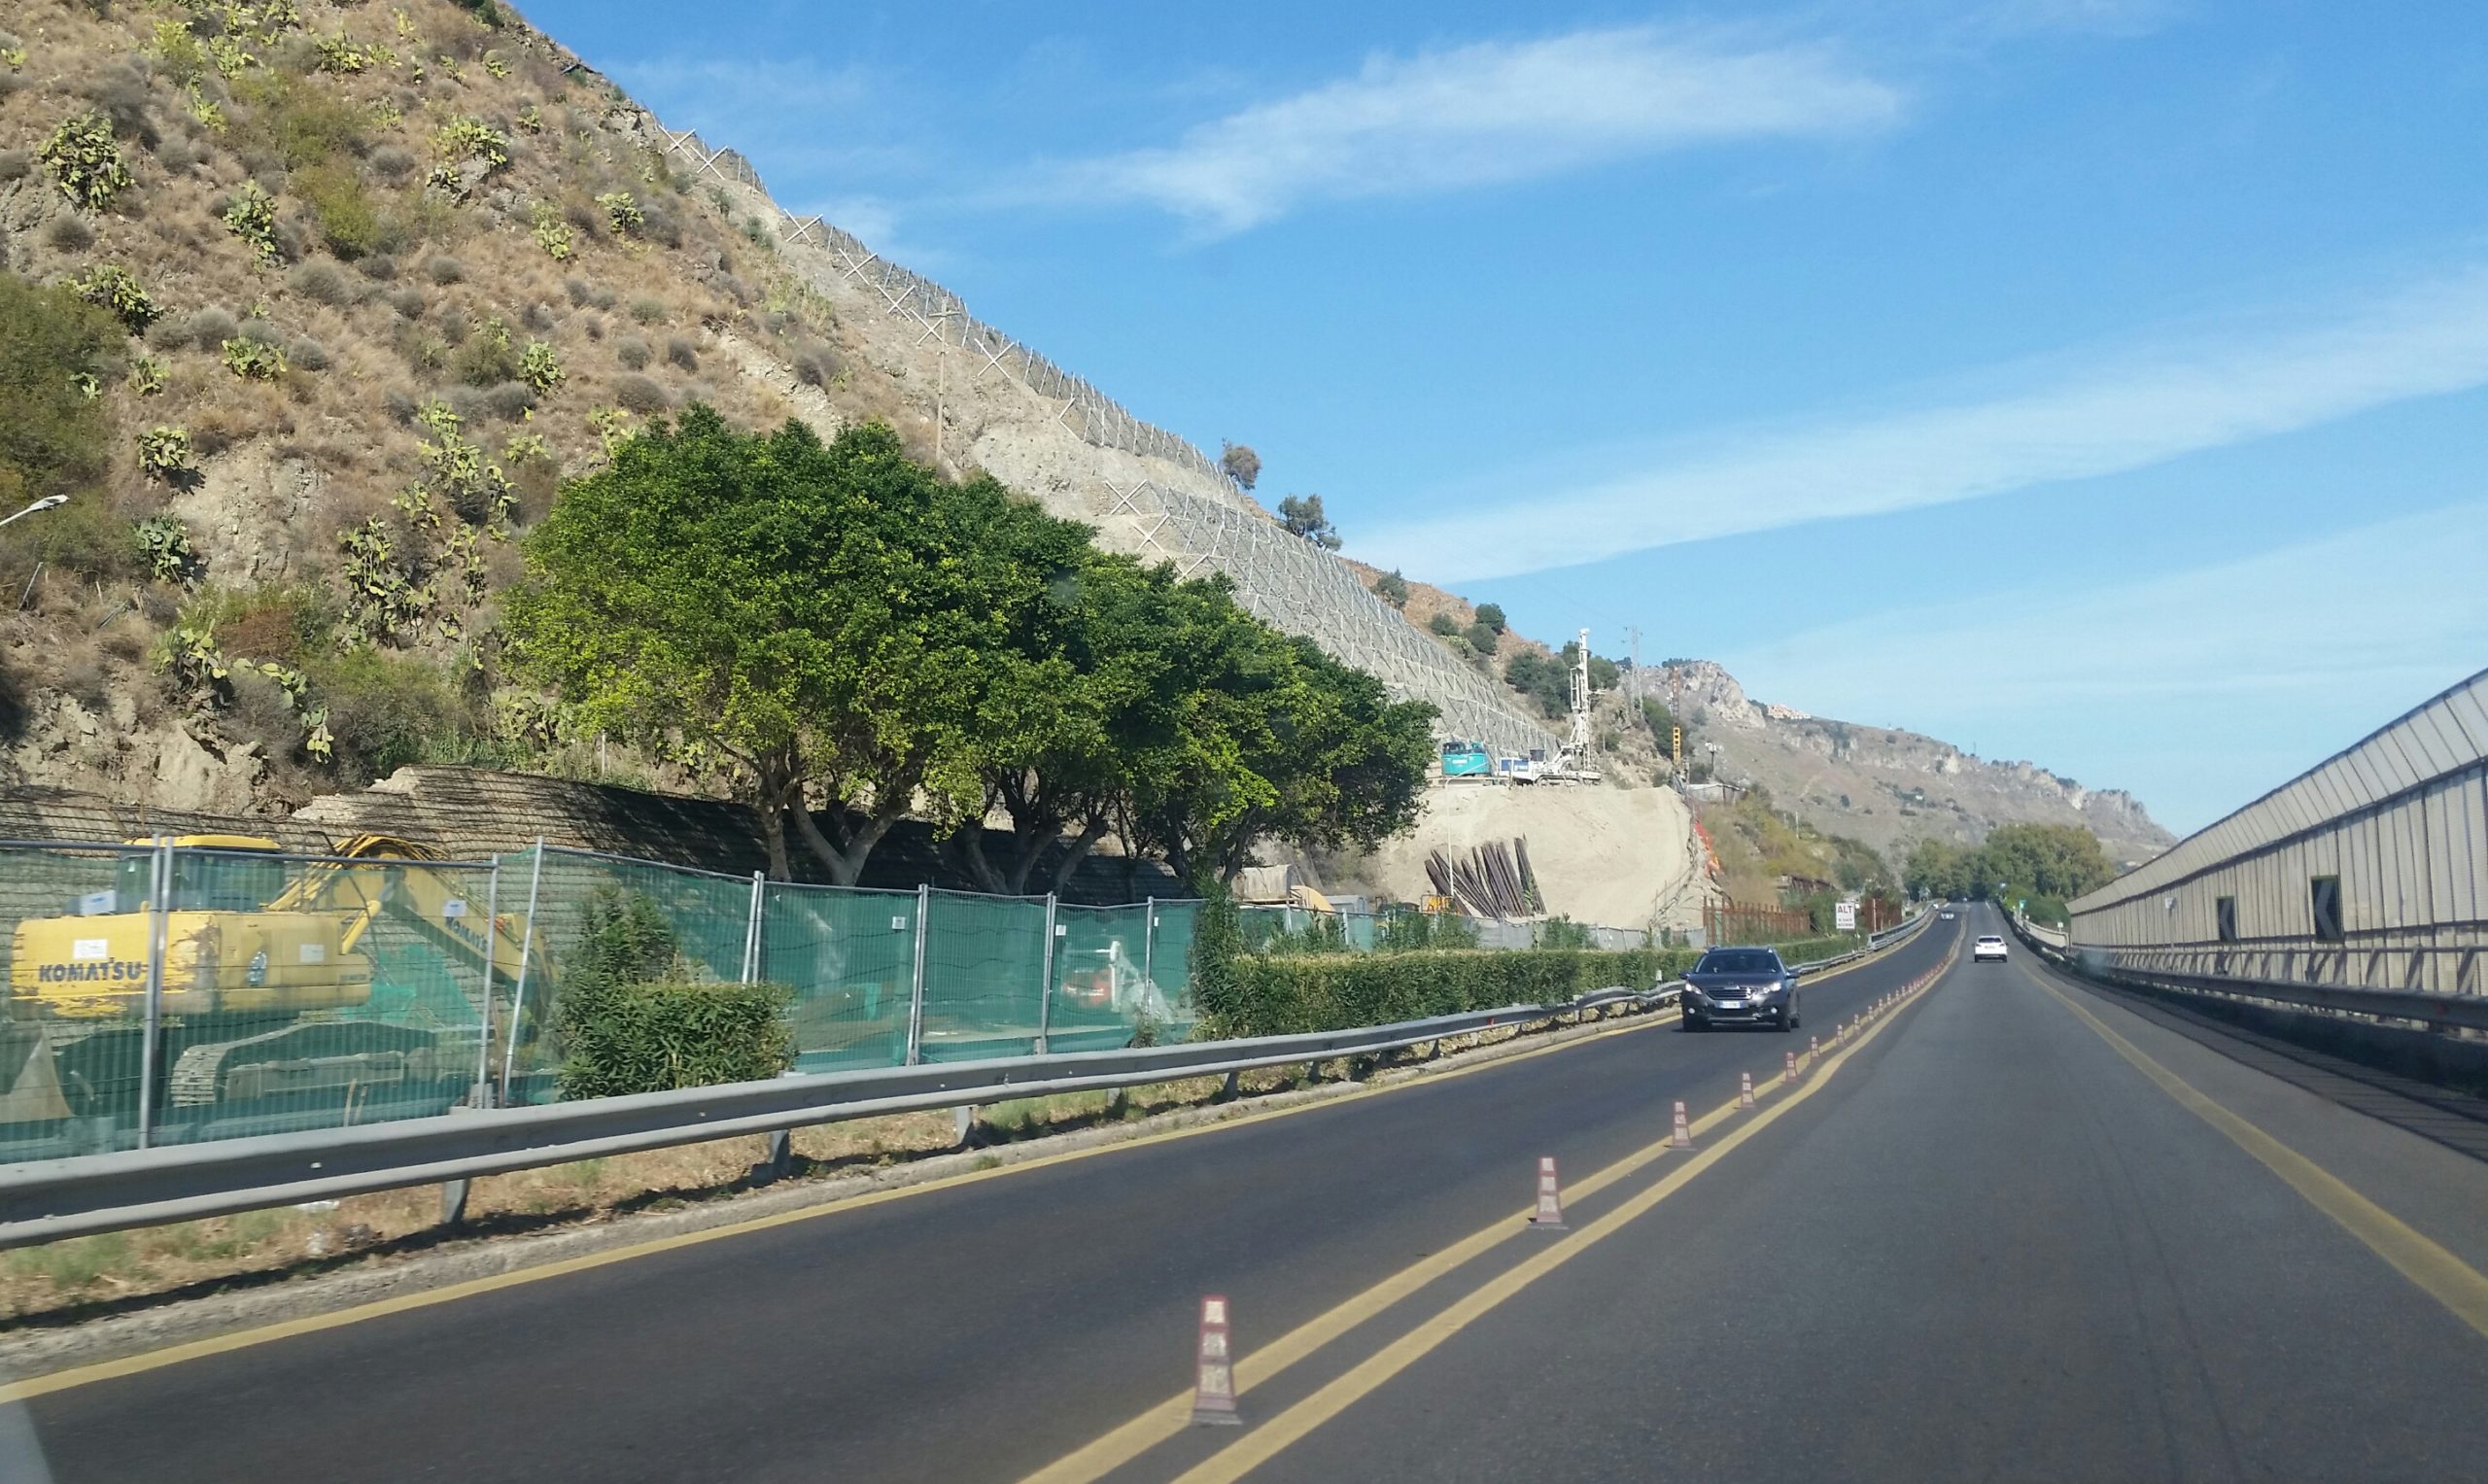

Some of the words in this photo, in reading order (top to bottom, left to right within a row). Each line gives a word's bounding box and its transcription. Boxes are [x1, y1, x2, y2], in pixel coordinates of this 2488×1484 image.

[1838, 905, 1852, 914] ALT
[445, 916, 489, 953] KOMATS
[39, 957, 142, 983] KOMATSU
